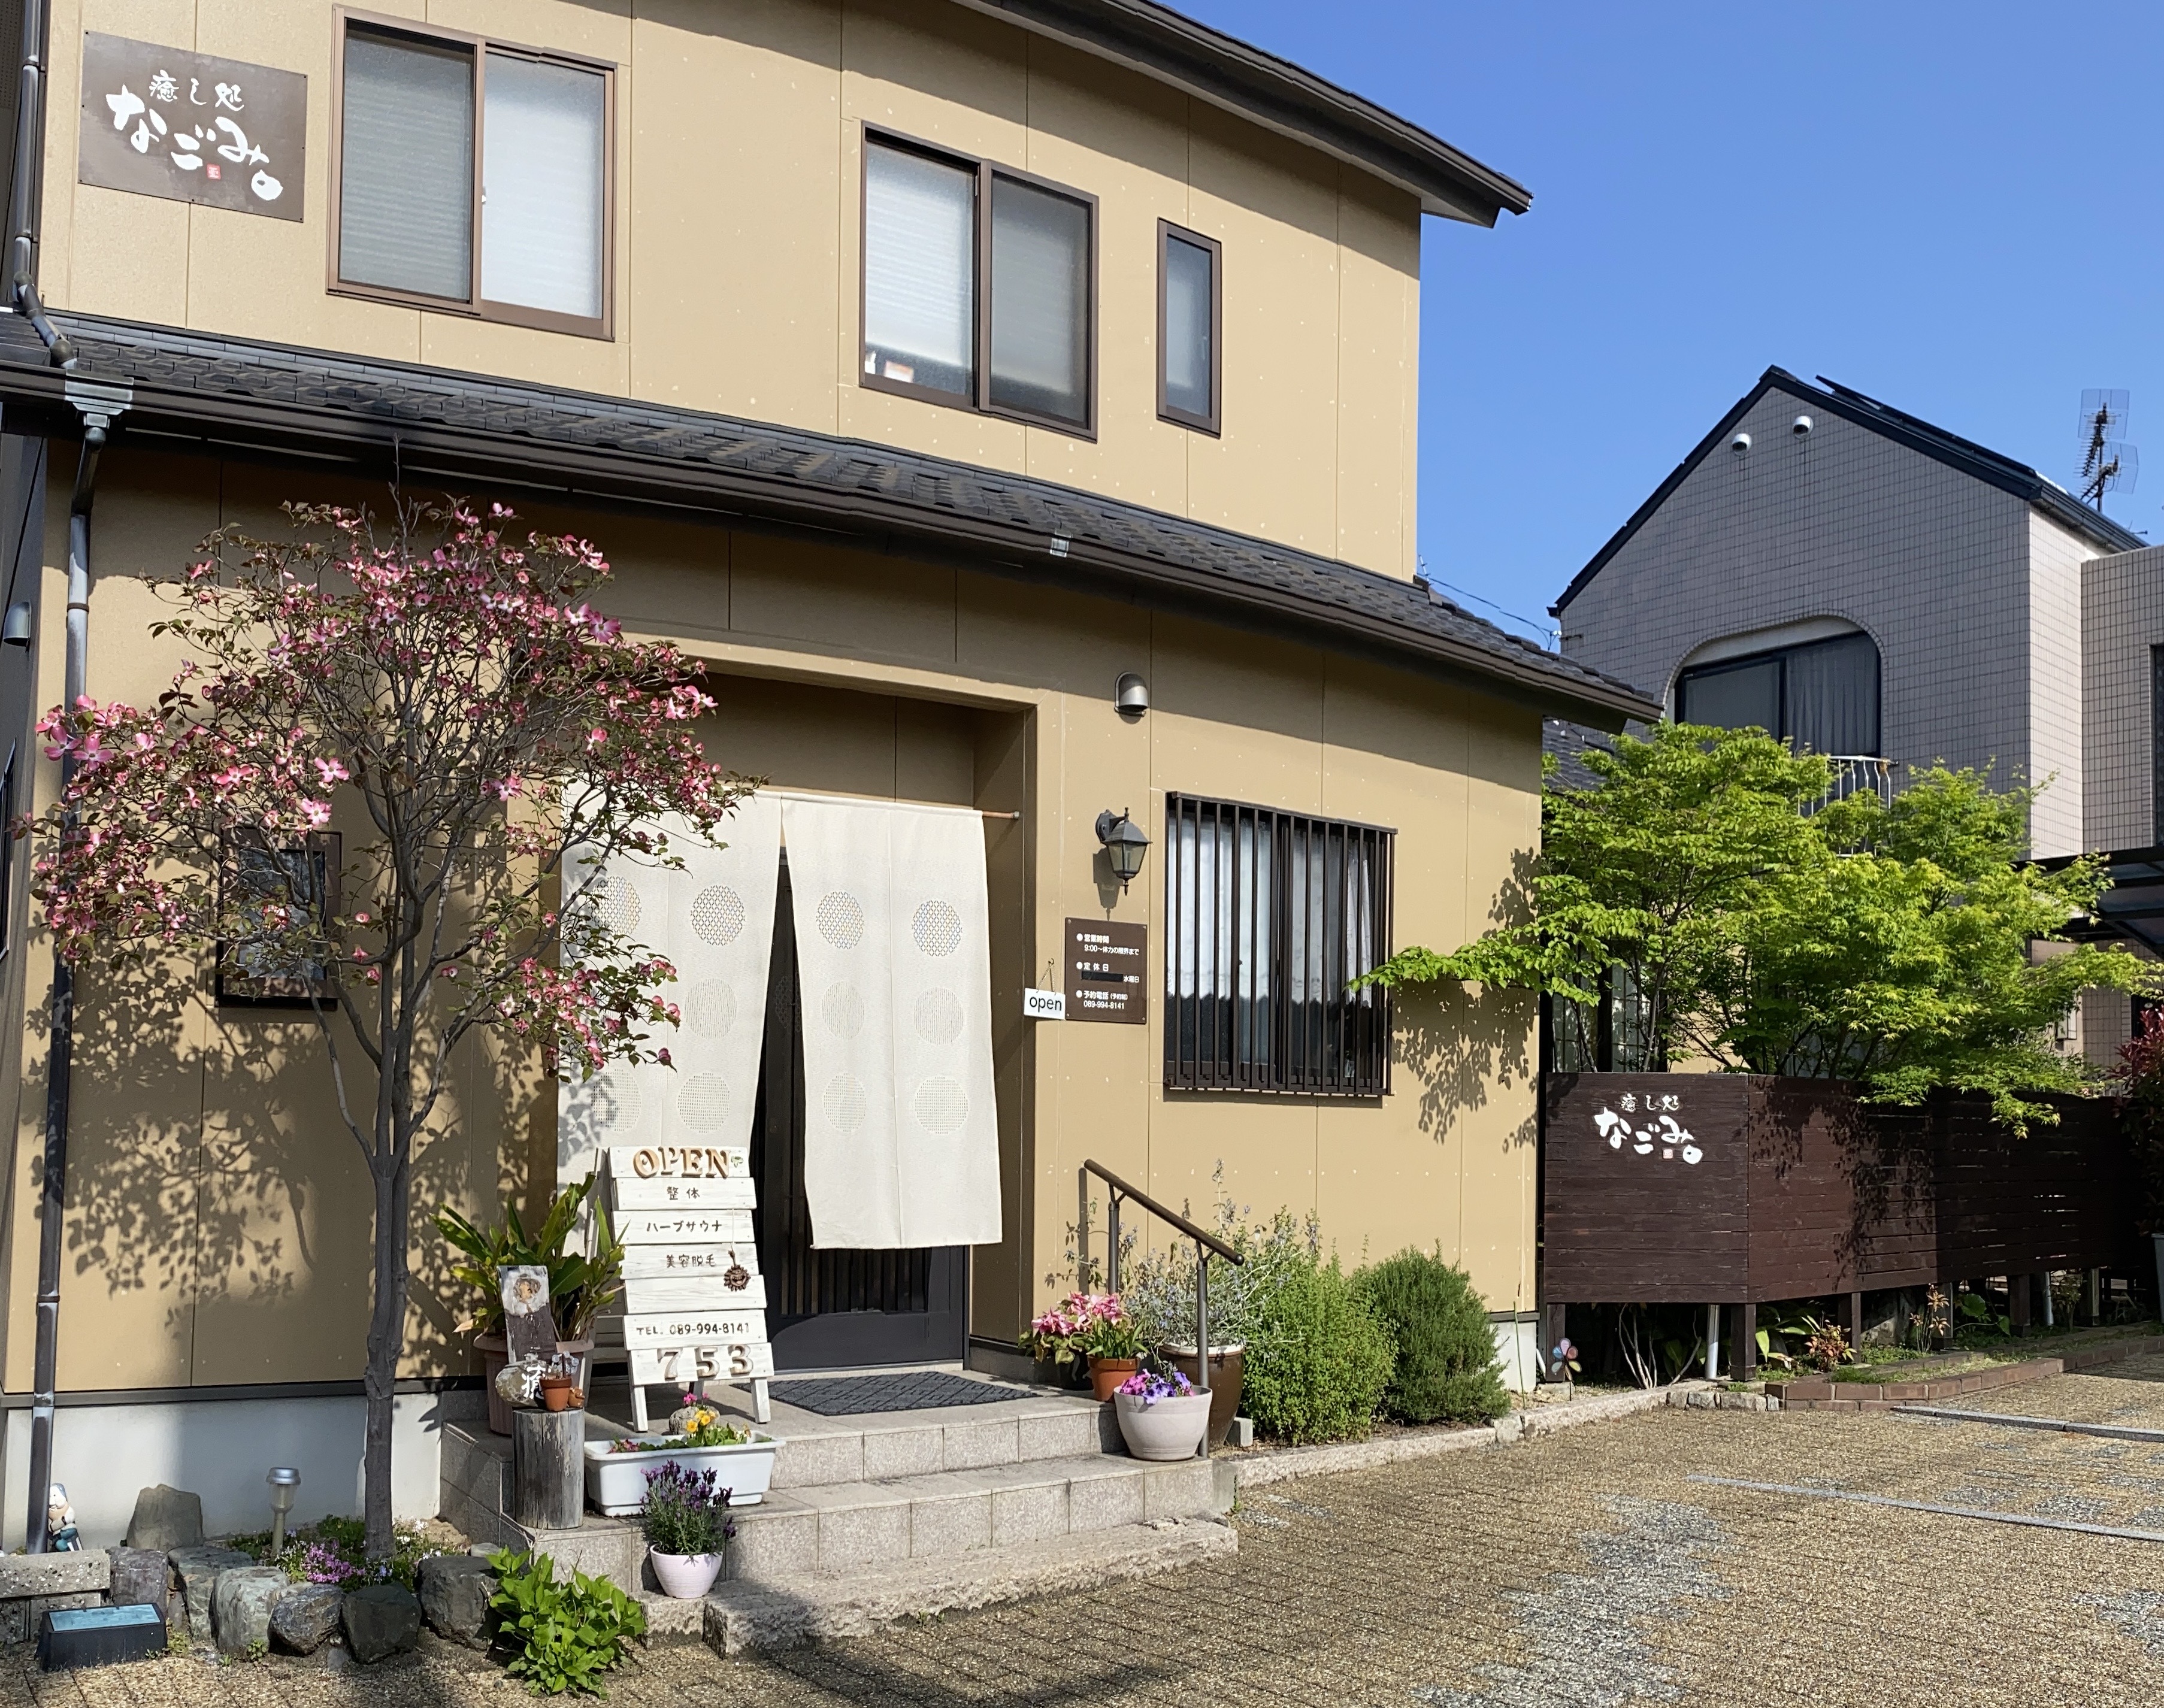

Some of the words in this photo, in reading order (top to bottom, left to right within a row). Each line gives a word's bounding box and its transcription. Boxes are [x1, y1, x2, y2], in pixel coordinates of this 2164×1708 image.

[149, 69, 245, 111] 癒し処
[1083, 934, 1109, 944] 営業時間
[1123, 975, 1140, 983] 水曜日
[1083, 990, 1109, 1000] 予約電話
[1029, 996, 1062, 1013] open
[1083, 1000, 1125, 1010] 089-994-8141
[1621, 1092, 1679, 1112] 癒し処
[632, 1146, 731, 1179] OPEN
[646, 1219, 722, 1232] ハーブサウナ
[666, 1253, 716, 1268] 美容脱毛
[669, 1322, 750, 1335] 089-994-8141
[657, 1344, 754, 1381] 753
